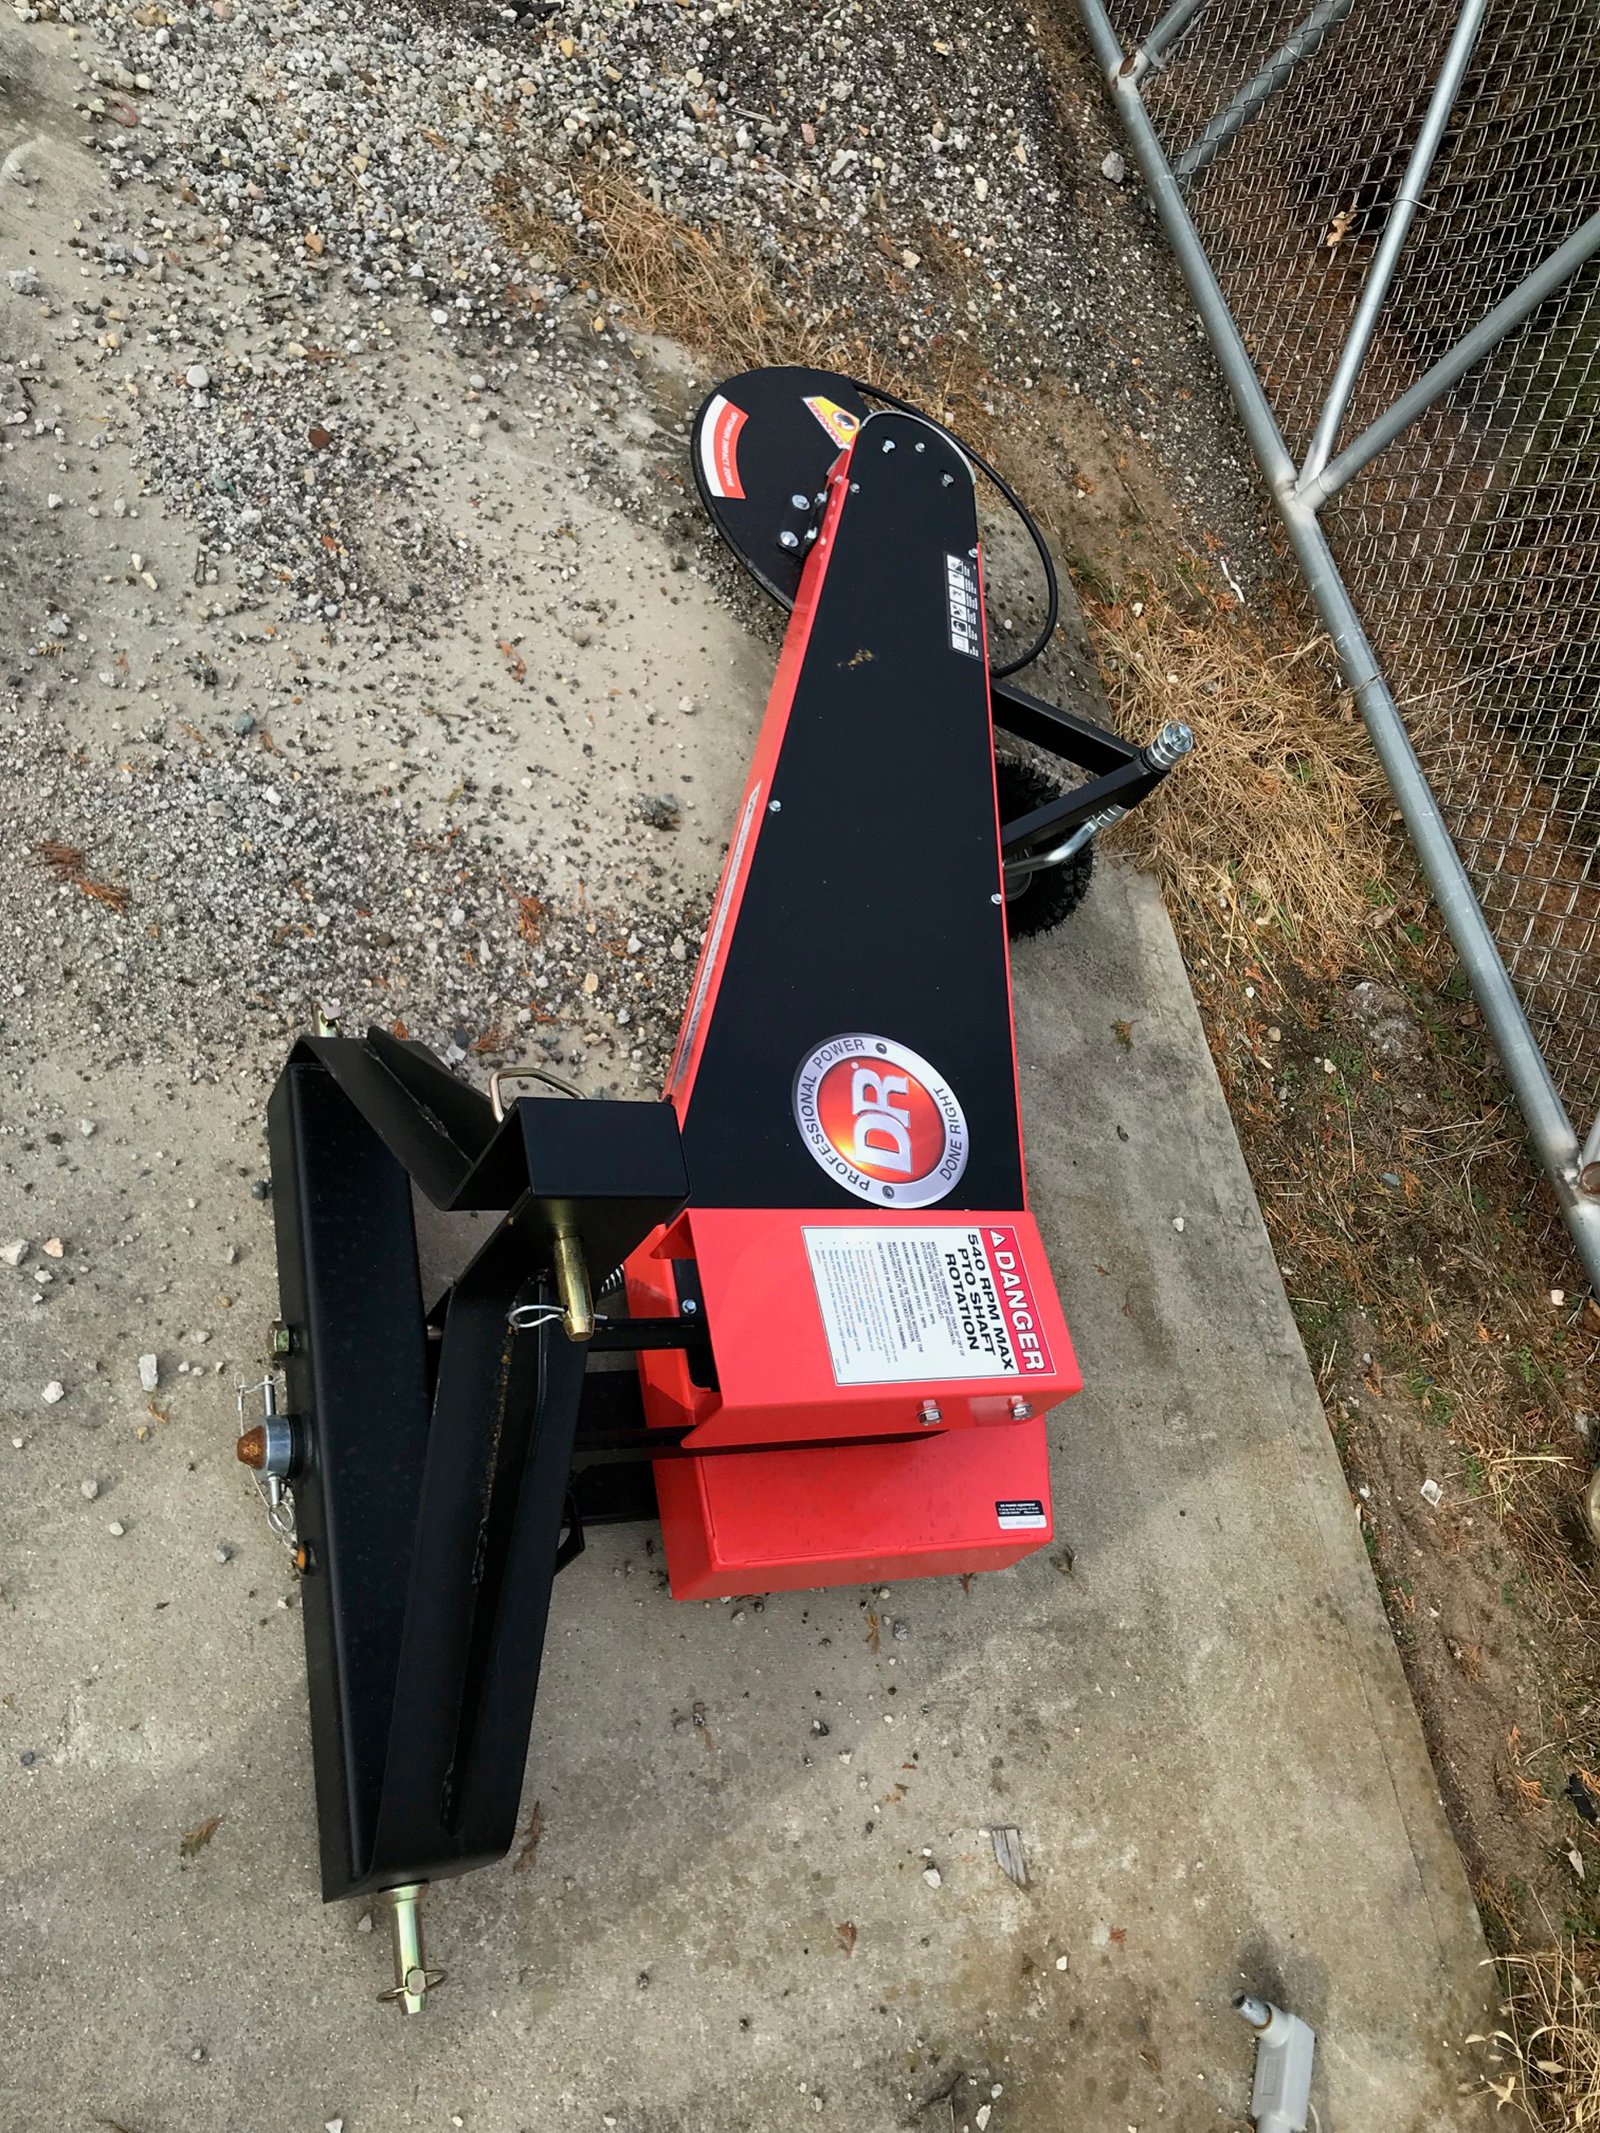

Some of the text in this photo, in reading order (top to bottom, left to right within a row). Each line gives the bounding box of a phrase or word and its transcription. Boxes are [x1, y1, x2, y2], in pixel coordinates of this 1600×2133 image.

[721, 439, 730, 465] IMPACT
[807, 401, 844, 447] DANGER
[723, 466, 735, 488] ZONE
[812, 1038, 866, 1069] POWER
[801, 1076, 870, 1192] PROFESSIONAL
[932, 1087, 963, 1182] DONE RIGHT
[944, 1253, 980, 1350] ROTATION
[956, 1247, 996, 1356] PTO SHAFT
[966, 1233, 1014, 1370] 540 RPM MAX
[992, 1250, 1046, 1370] DANGER
